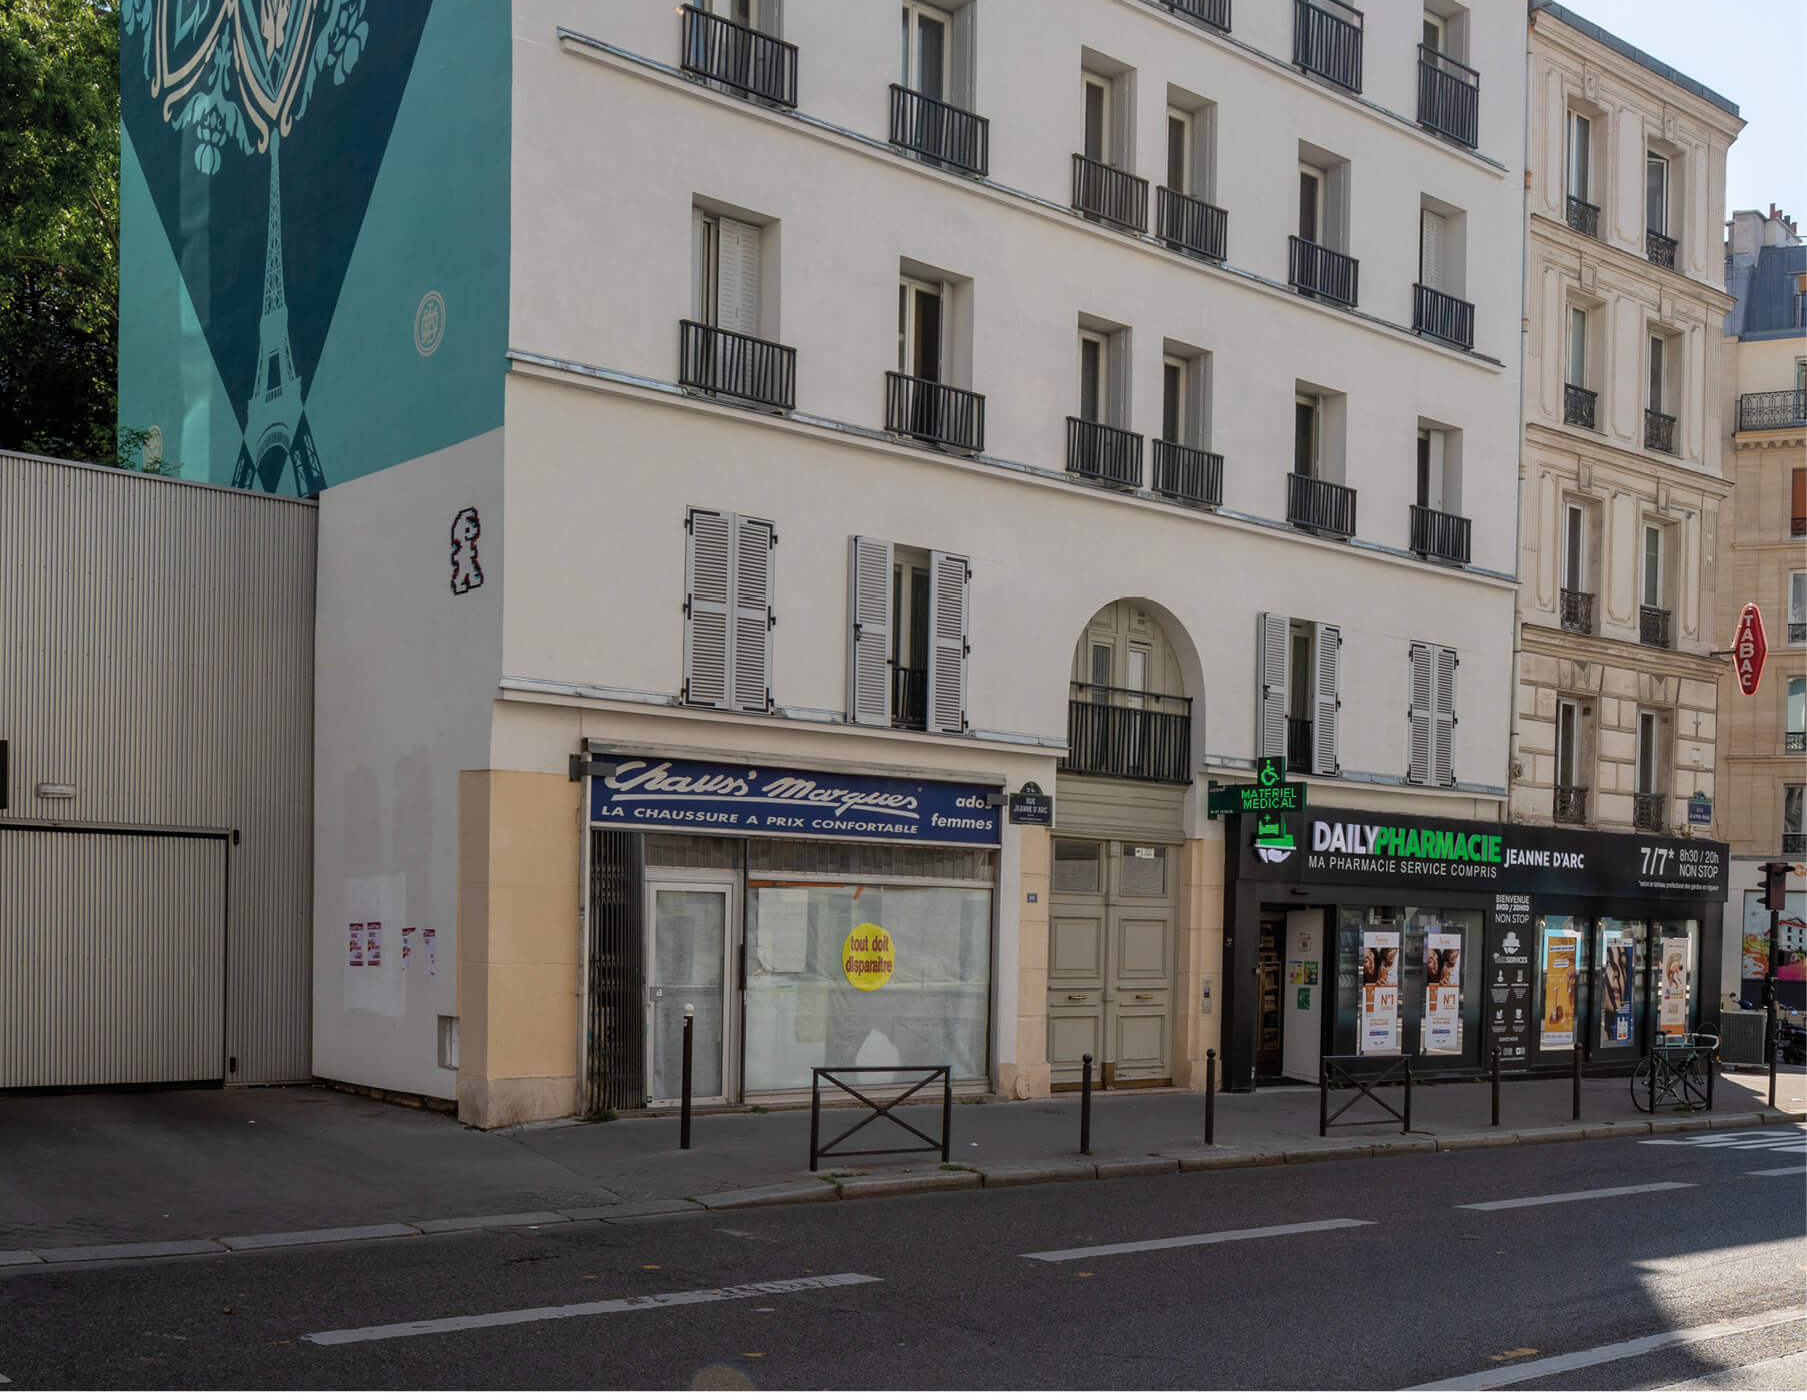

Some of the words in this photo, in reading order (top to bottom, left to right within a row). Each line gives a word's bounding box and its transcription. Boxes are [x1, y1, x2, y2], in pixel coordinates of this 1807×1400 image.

[1740, 615, 1754, 686] TABAC
[762, 777, 918, 816] Marques
[1241, 788, 1297, 799] MATERIEL
[1243, 798, 1296, 809] MEDICAL
[602, 806, 625, 817] LA
[634, 807, 739, 823] CHAUSSURE
[746, 815, 758, 825] A
[766, 816, 804, 828] PRIX
[812, 819, 919, 834] CONFORTABLE
[931, 813, 993, 830] femmes
[1504, 848, 1550, 868] JEANNE
[1553, 851, 1585, 869] D'ARC
[1680, 849, 1698, 862] 8h30
[1705, 851, 1719, 864] 20h
[1308, 856, 1325, 869] MA
[1330, 856, 1396, 873] PHARMACIE
[1400, 861, 1447, 875] SERVICE
[1451, 864, 1497, 879] COMPRIS
[1680, 864, 1697, 877] NON
[1698, 865, 1718, 878] STOP
[1496, 895, 1530, 904] BIENVENUE
[1496, 913, 1511, 923] NON
[1512, 914, 1530, 924] STOP
[850, 936, 868, 952] tout
[872, 936, 889, 952] doit
